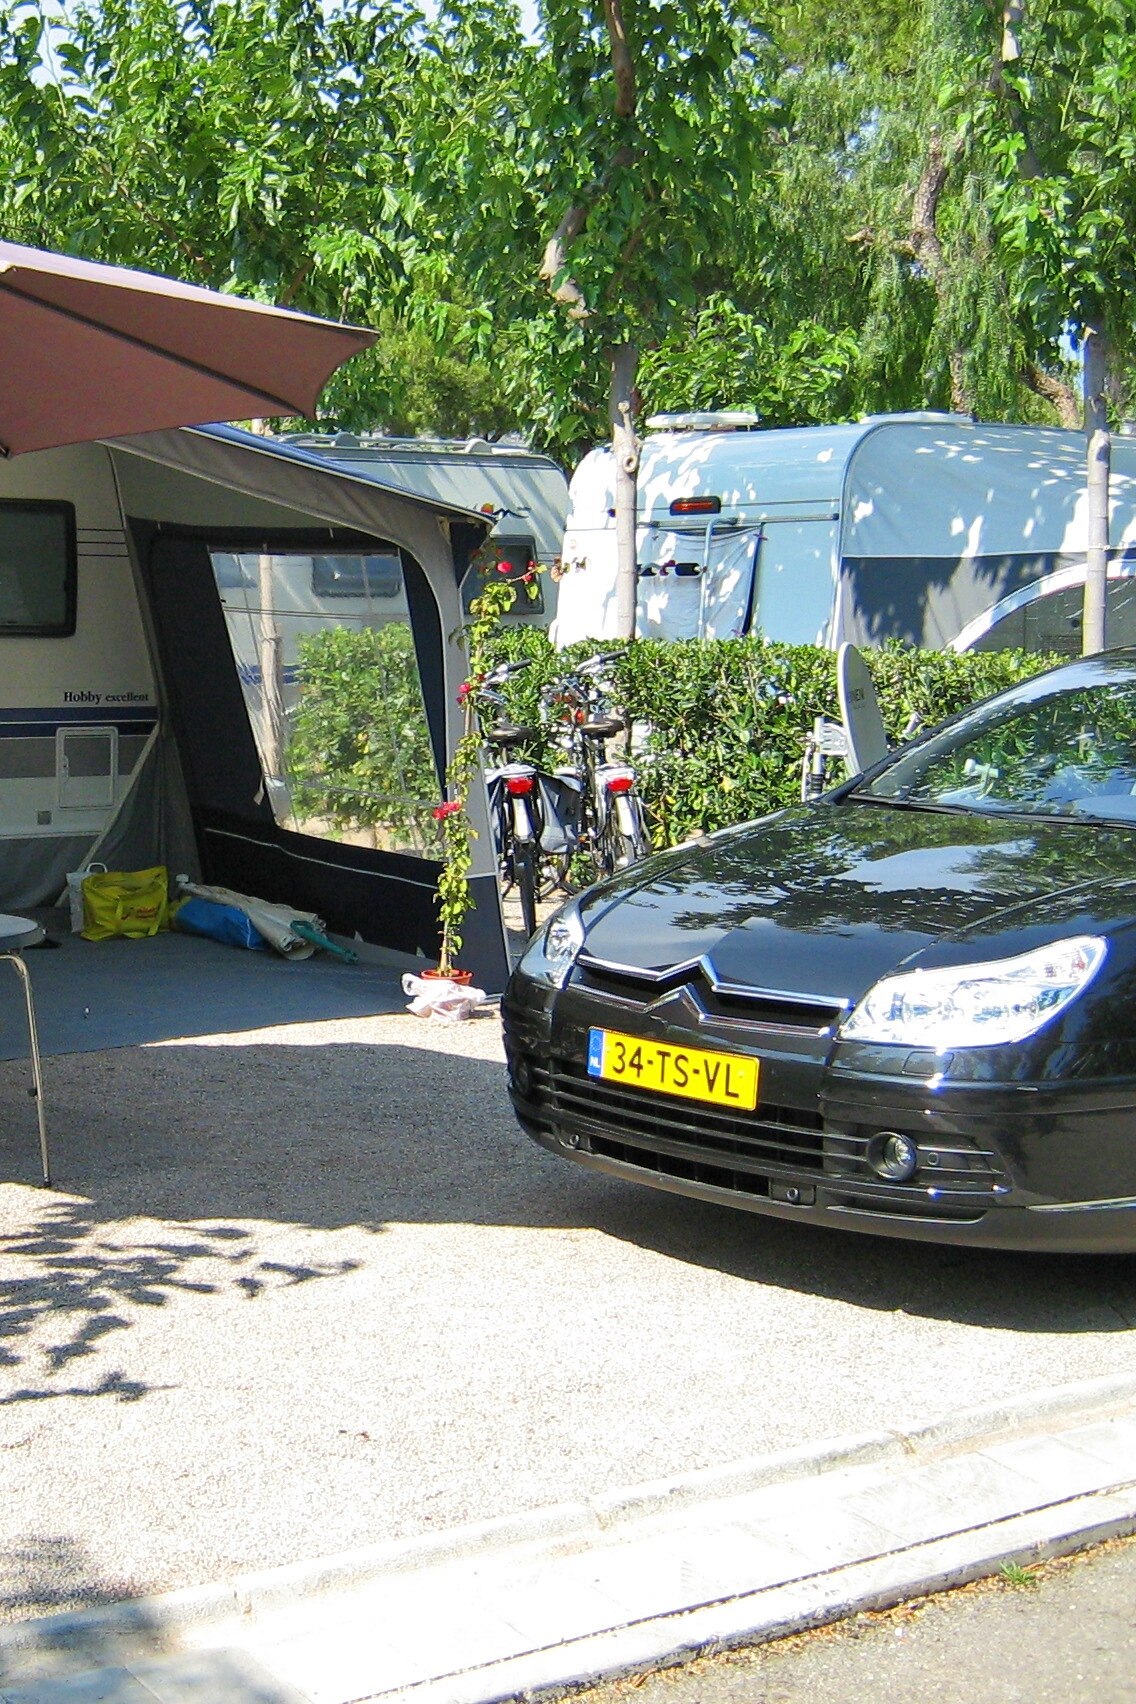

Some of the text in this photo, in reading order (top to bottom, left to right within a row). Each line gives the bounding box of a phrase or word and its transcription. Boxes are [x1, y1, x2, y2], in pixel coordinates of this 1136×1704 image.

[64, 690, 149, 705] Hobby excellent
[589, 1056, 601, 1068] NL
[612, 1041, 740, 1099] 34-TS-VL
